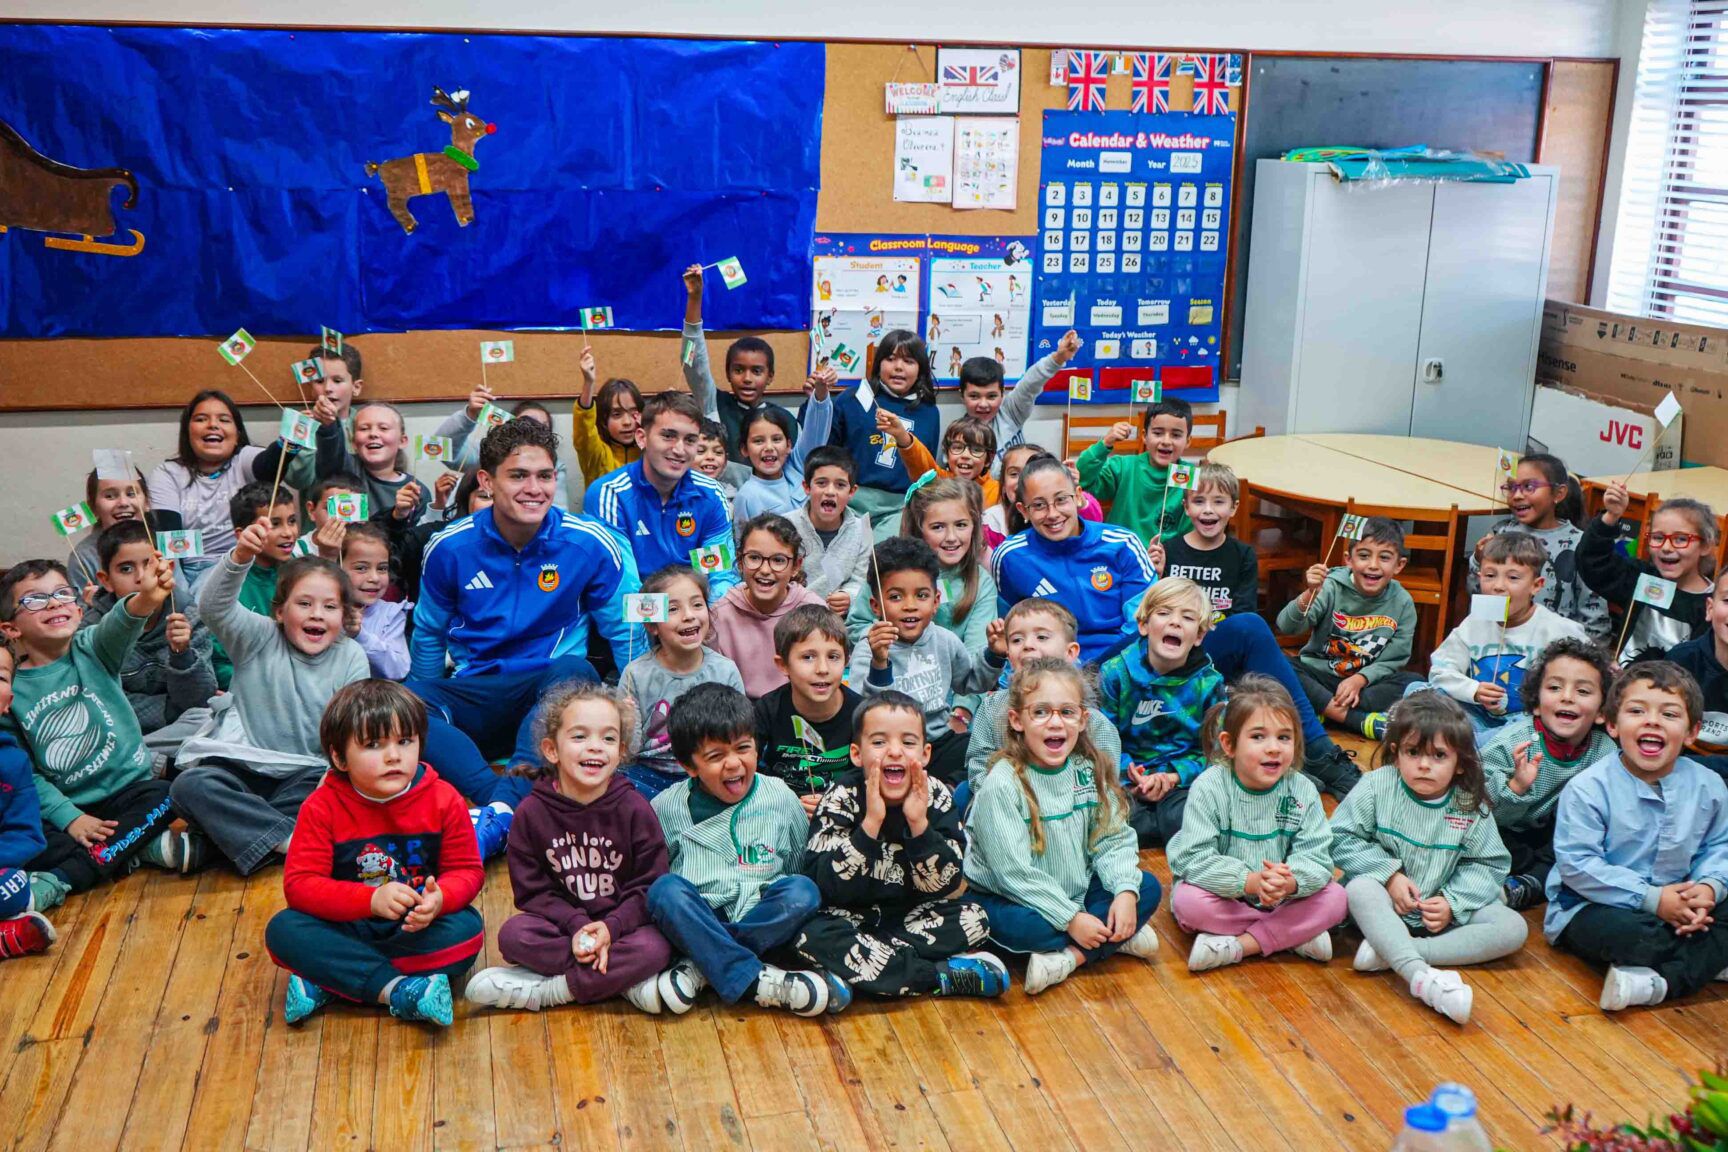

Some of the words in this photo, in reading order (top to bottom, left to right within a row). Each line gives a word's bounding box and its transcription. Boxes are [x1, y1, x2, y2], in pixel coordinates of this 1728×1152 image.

[1069, 132, 1134, 149] Calendar
[1135, 132, 1148, 149] &
[1150, 132, 1210, 149] Weather
[1066, 159, 1095, 168] Month
[1147, 160, 1167, 169] Year
[1076, 213, 1089, 223] 10
[1102, 213, 1114, 223] 11
[1127, 213, 1140, 223] 12
[1154, 213, 1167, 223] 13
[1180, 213, 1193, 223] 14
[1205, 213, 1218, 223] 15
[1047, 235, 1060, 245] 16
[1074, 236, 1086, 245] 17
[1101, 235, 1113, 245] 18
[1126, 235, 1139, 245] 19
[1152, 235, 1166, 245] 20
[1177, 235, 1190, 245] 21
[1203, 235, 1216, 245] 22
[869, 239, 925, 251] Classroom
[927, 238, 980, 255] Language
[850, 261, 883, 269] Student
[970, 262, 1002, 270] Teacher
[1046, 257, 1060, 267] 23
[1073, 257, 1086, 267] 24
[1099, 257, 1112, 267] 25
[1124, 257, 1138, 267] 26
[1042, 299, 1075, 307] Yesterda
[1097, 299, 1116, 307] Today
[1102, 331, 1125, 339] Today's
[1600, 419, 1643, 449] JVC
[1170, 564, 1221, 581] BETTER
[1136, 700, 1165, 715] NIKE
[552, 831, 576, 848] self
[583, 831, 613, 848] love
[565, 873, 615, 901] CLUB
